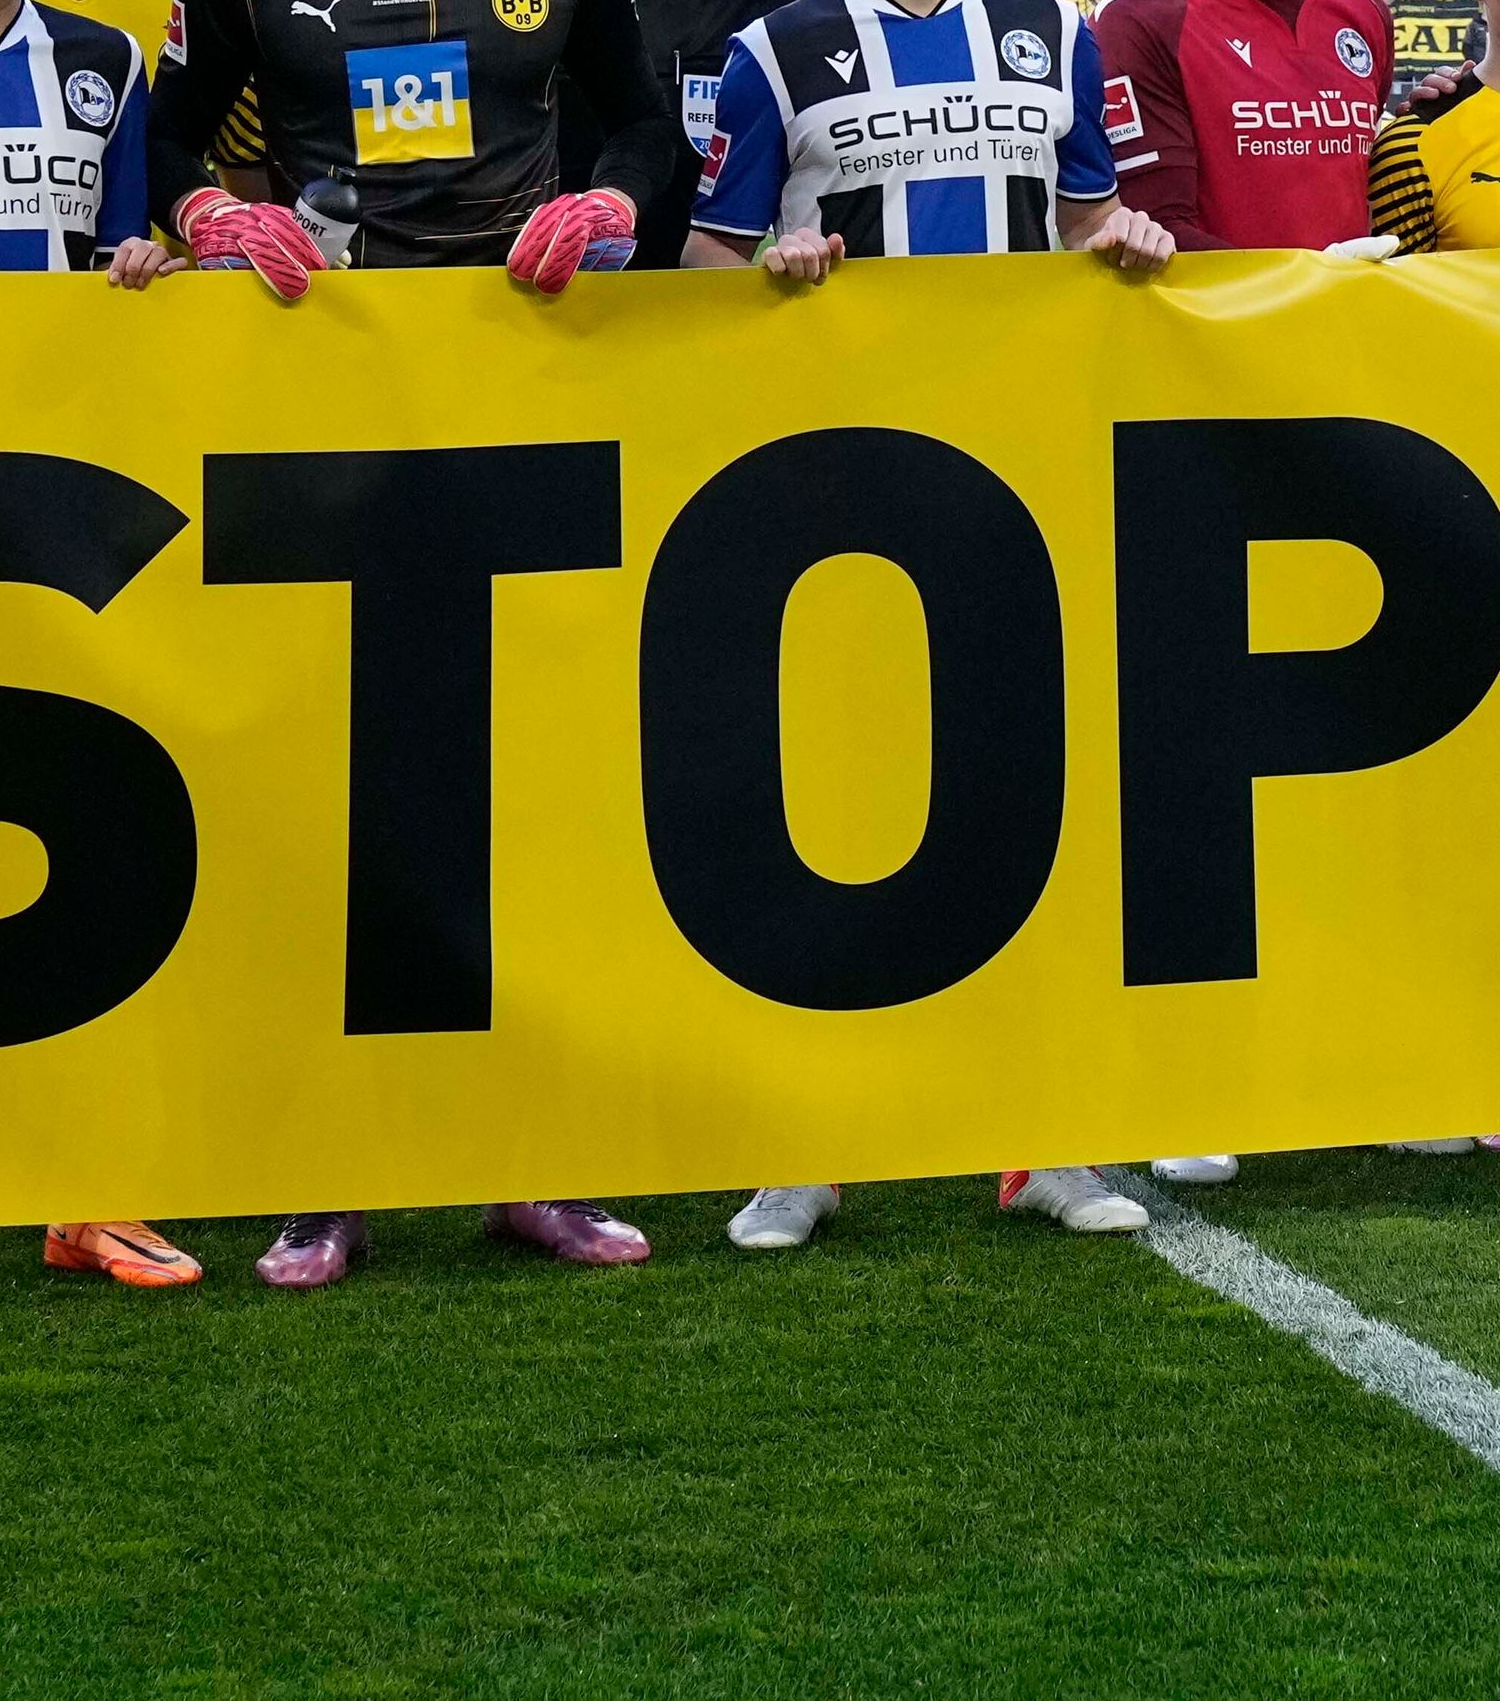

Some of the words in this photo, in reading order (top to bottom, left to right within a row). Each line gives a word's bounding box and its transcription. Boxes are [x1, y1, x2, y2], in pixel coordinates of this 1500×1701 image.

[515, 13, 532, 26] 09
[689, 80, 721, 100] FIF
[361, 70, 457, 133] 1&1
[687, 112, 714, 124] REFE
[829, 95, 1048, 151] SCHÜCO
[1107, 127, 1138, 140] DESLIGA
[1237, 134, 1312, 157] Fenster
[1318, 133, 1352, 155] und
[839, 147, 925, 176] Fenster
[934, 139, 979, 162] und
